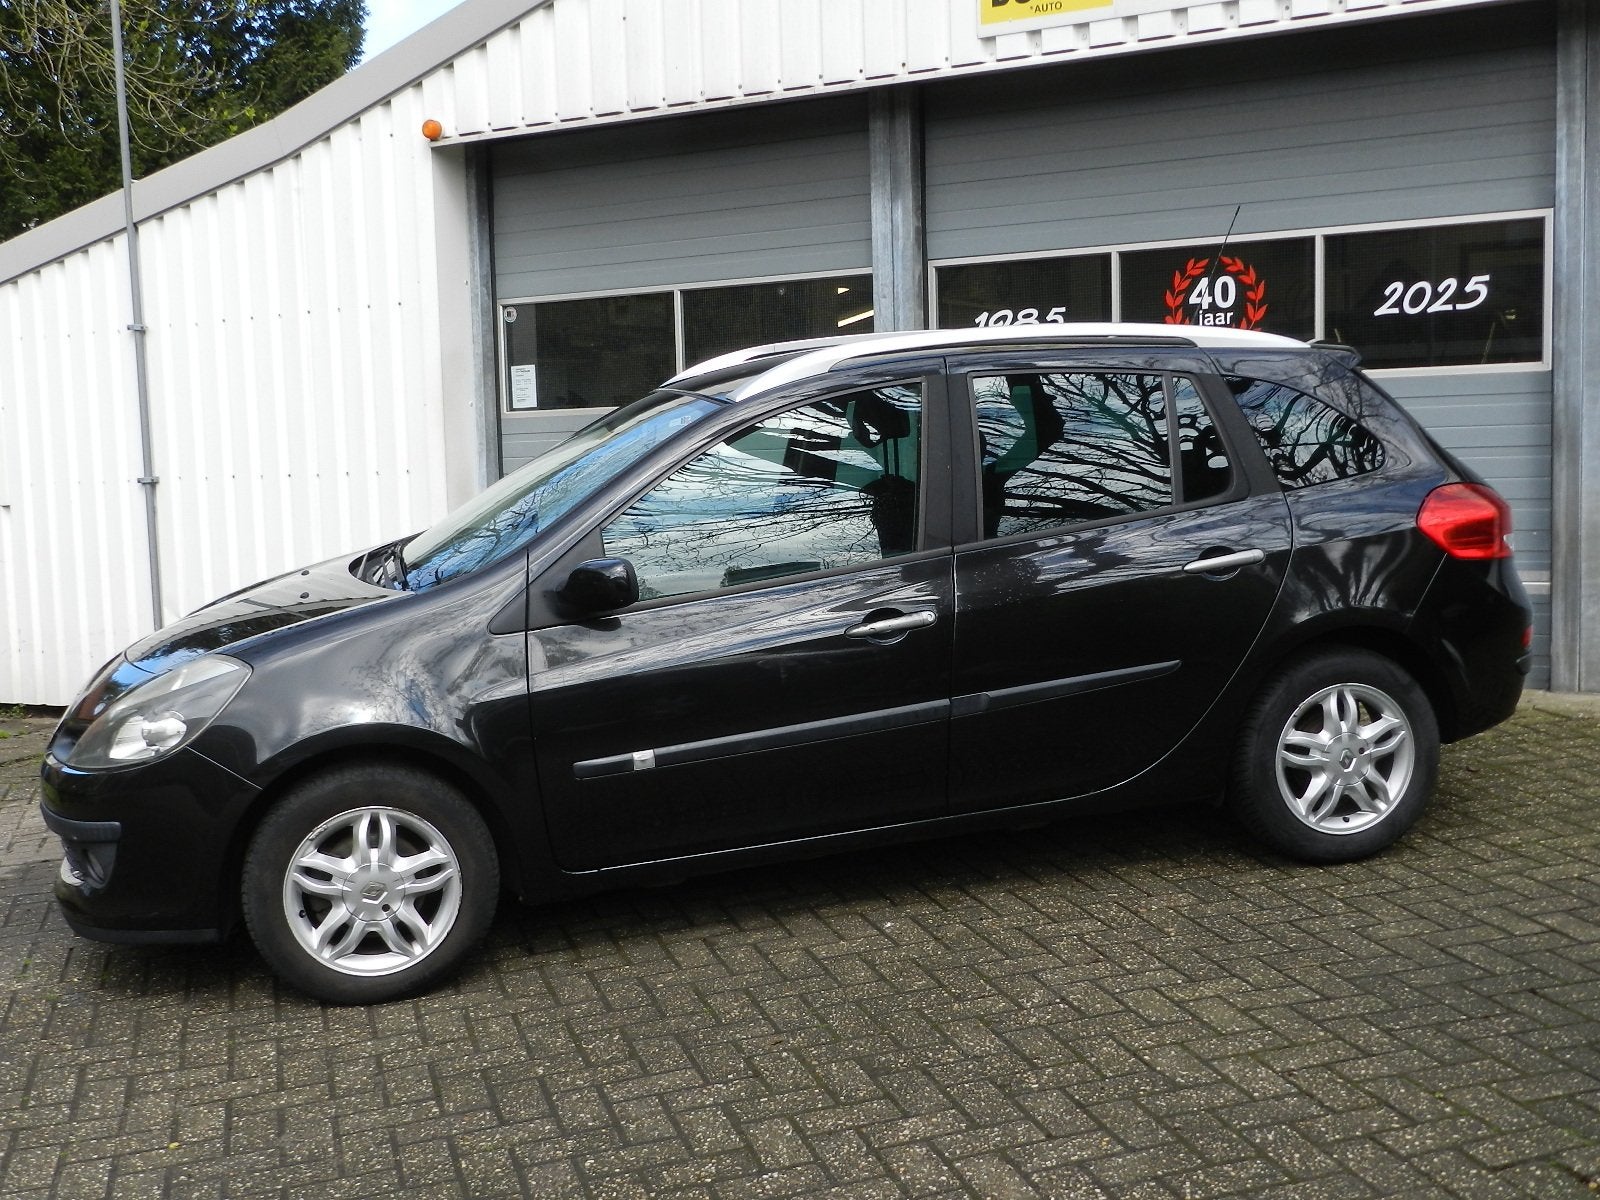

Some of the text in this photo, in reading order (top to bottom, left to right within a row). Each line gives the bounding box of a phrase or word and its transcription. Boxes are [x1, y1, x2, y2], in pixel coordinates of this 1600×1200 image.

[1189, 275, 1236, 310] 40
[1373, 274, 1490, 316] 2025
[1198, 310, 1234, 326] jaar
